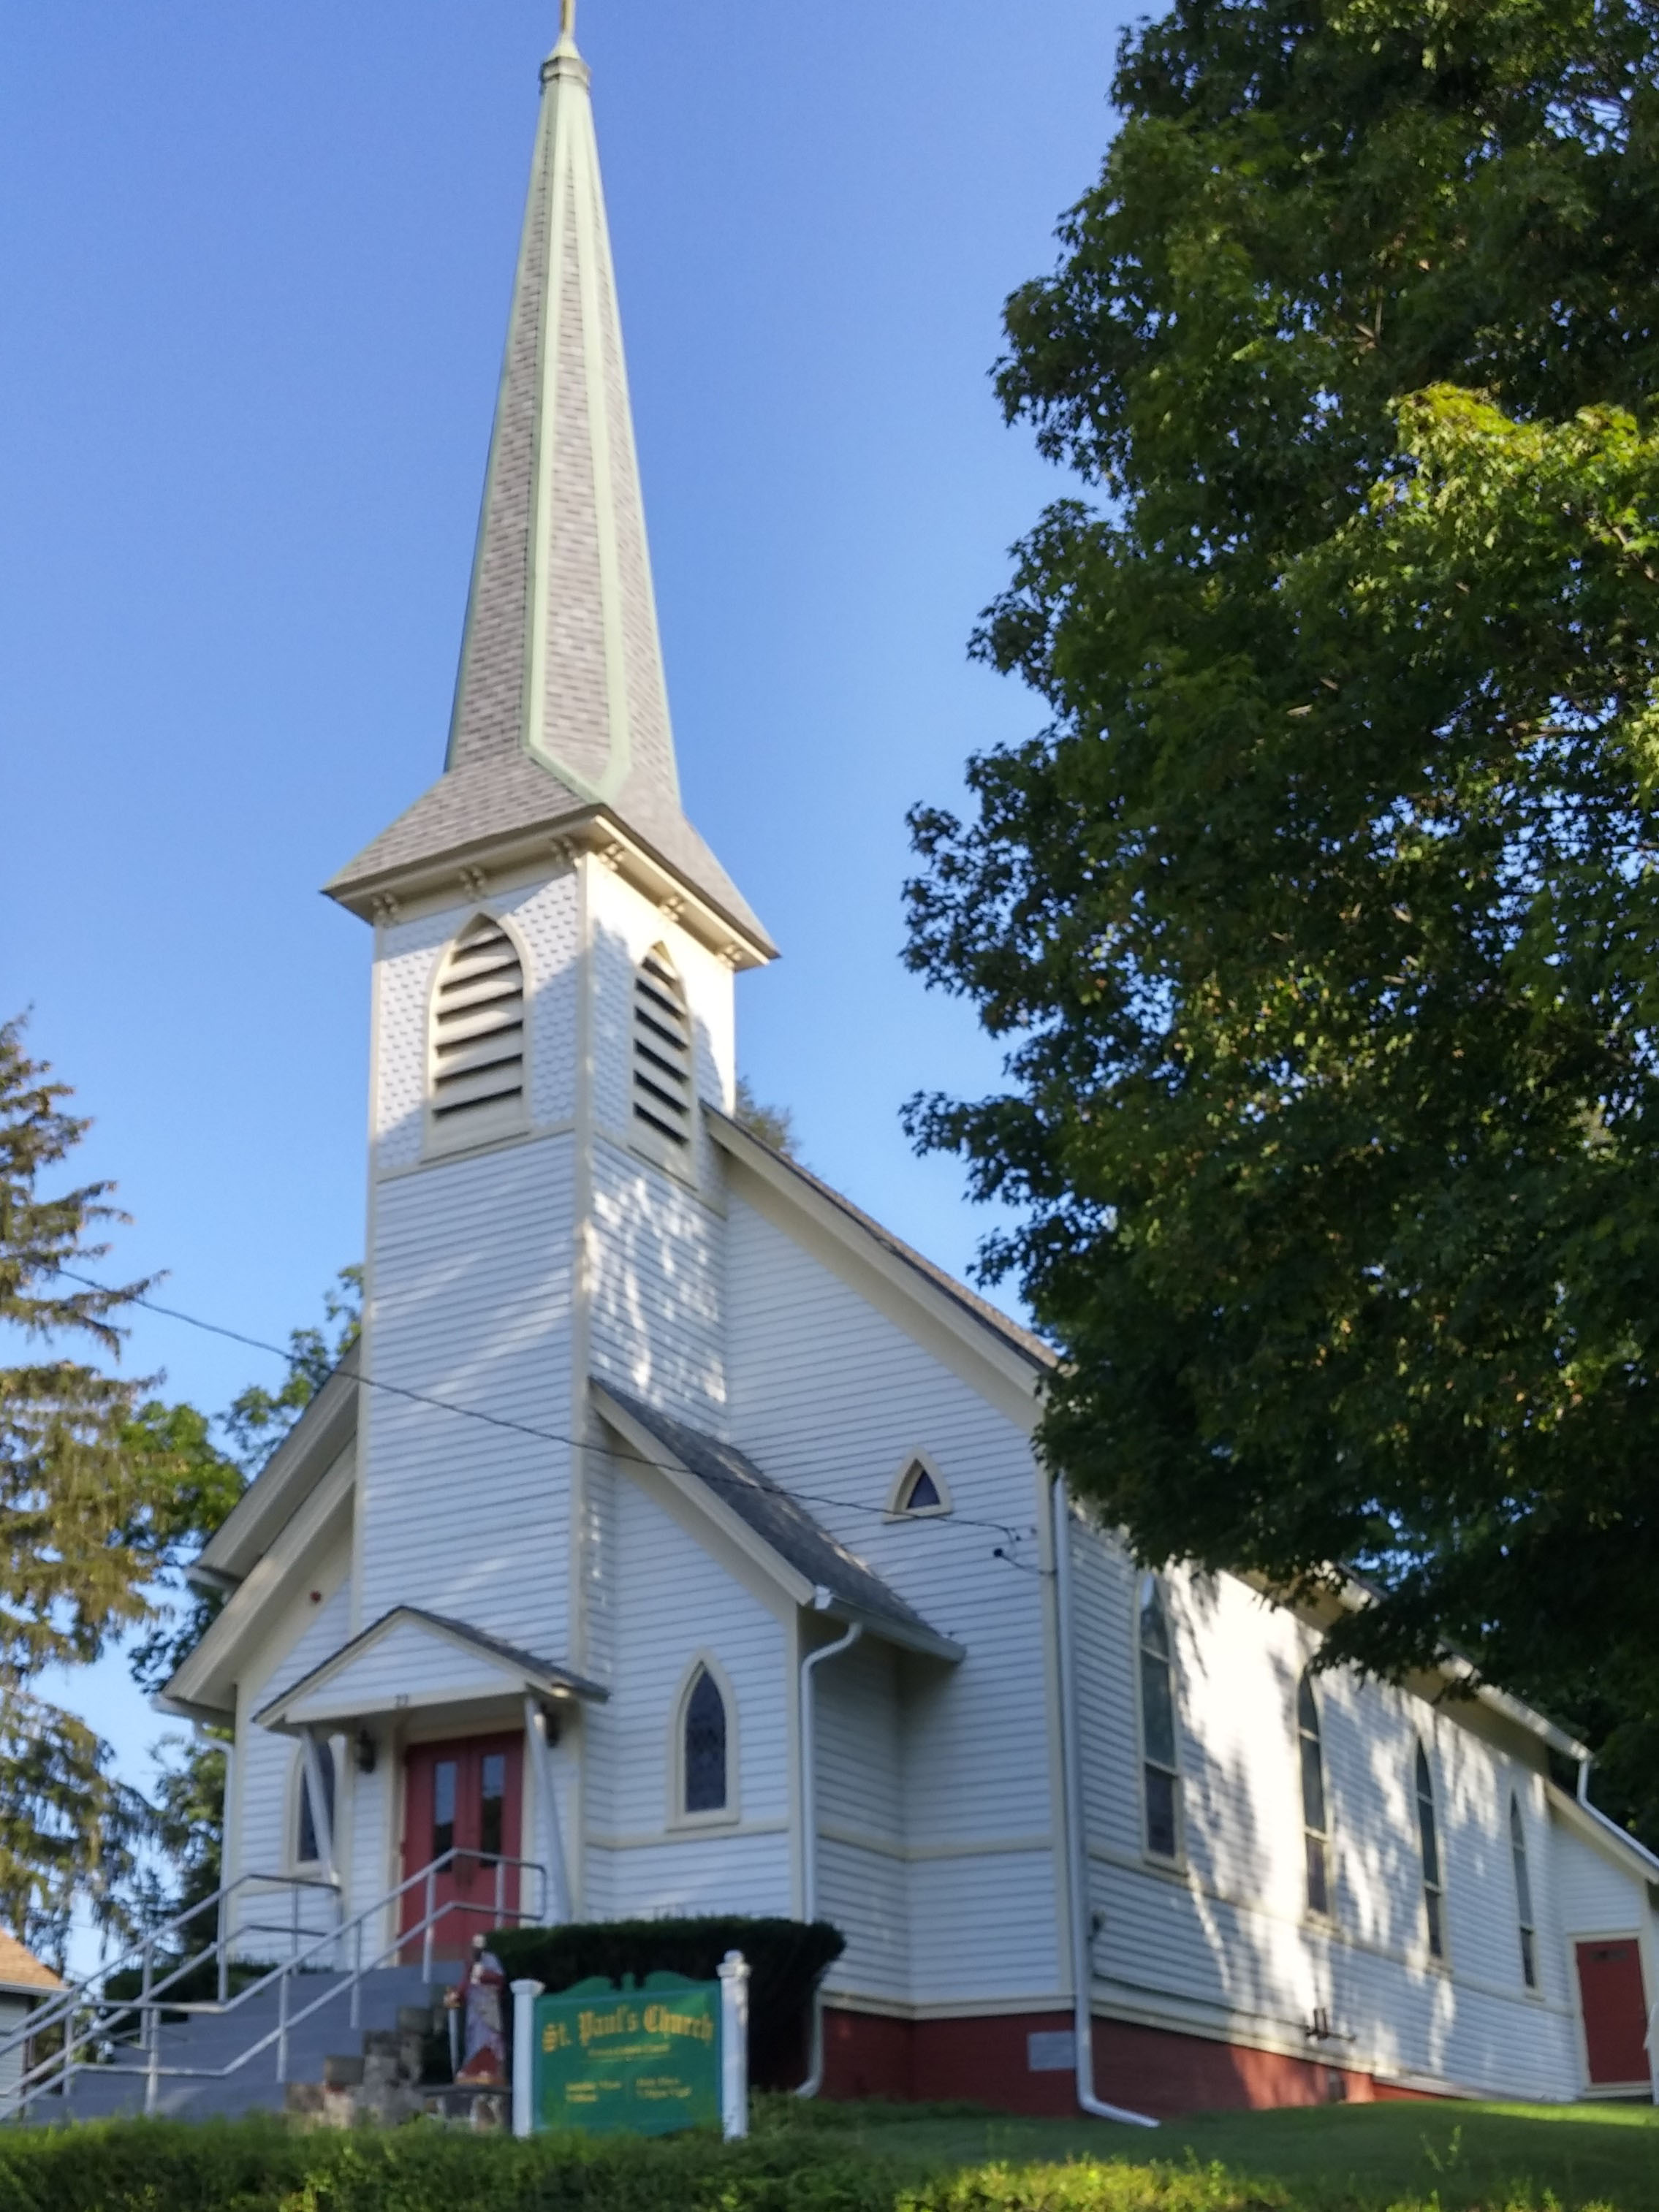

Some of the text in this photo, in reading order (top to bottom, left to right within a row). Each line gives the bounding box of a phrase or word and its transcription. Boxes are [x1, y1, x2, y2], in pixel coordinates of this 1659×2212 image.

[543, 2004, 713, 2053] St. Paul's Church
